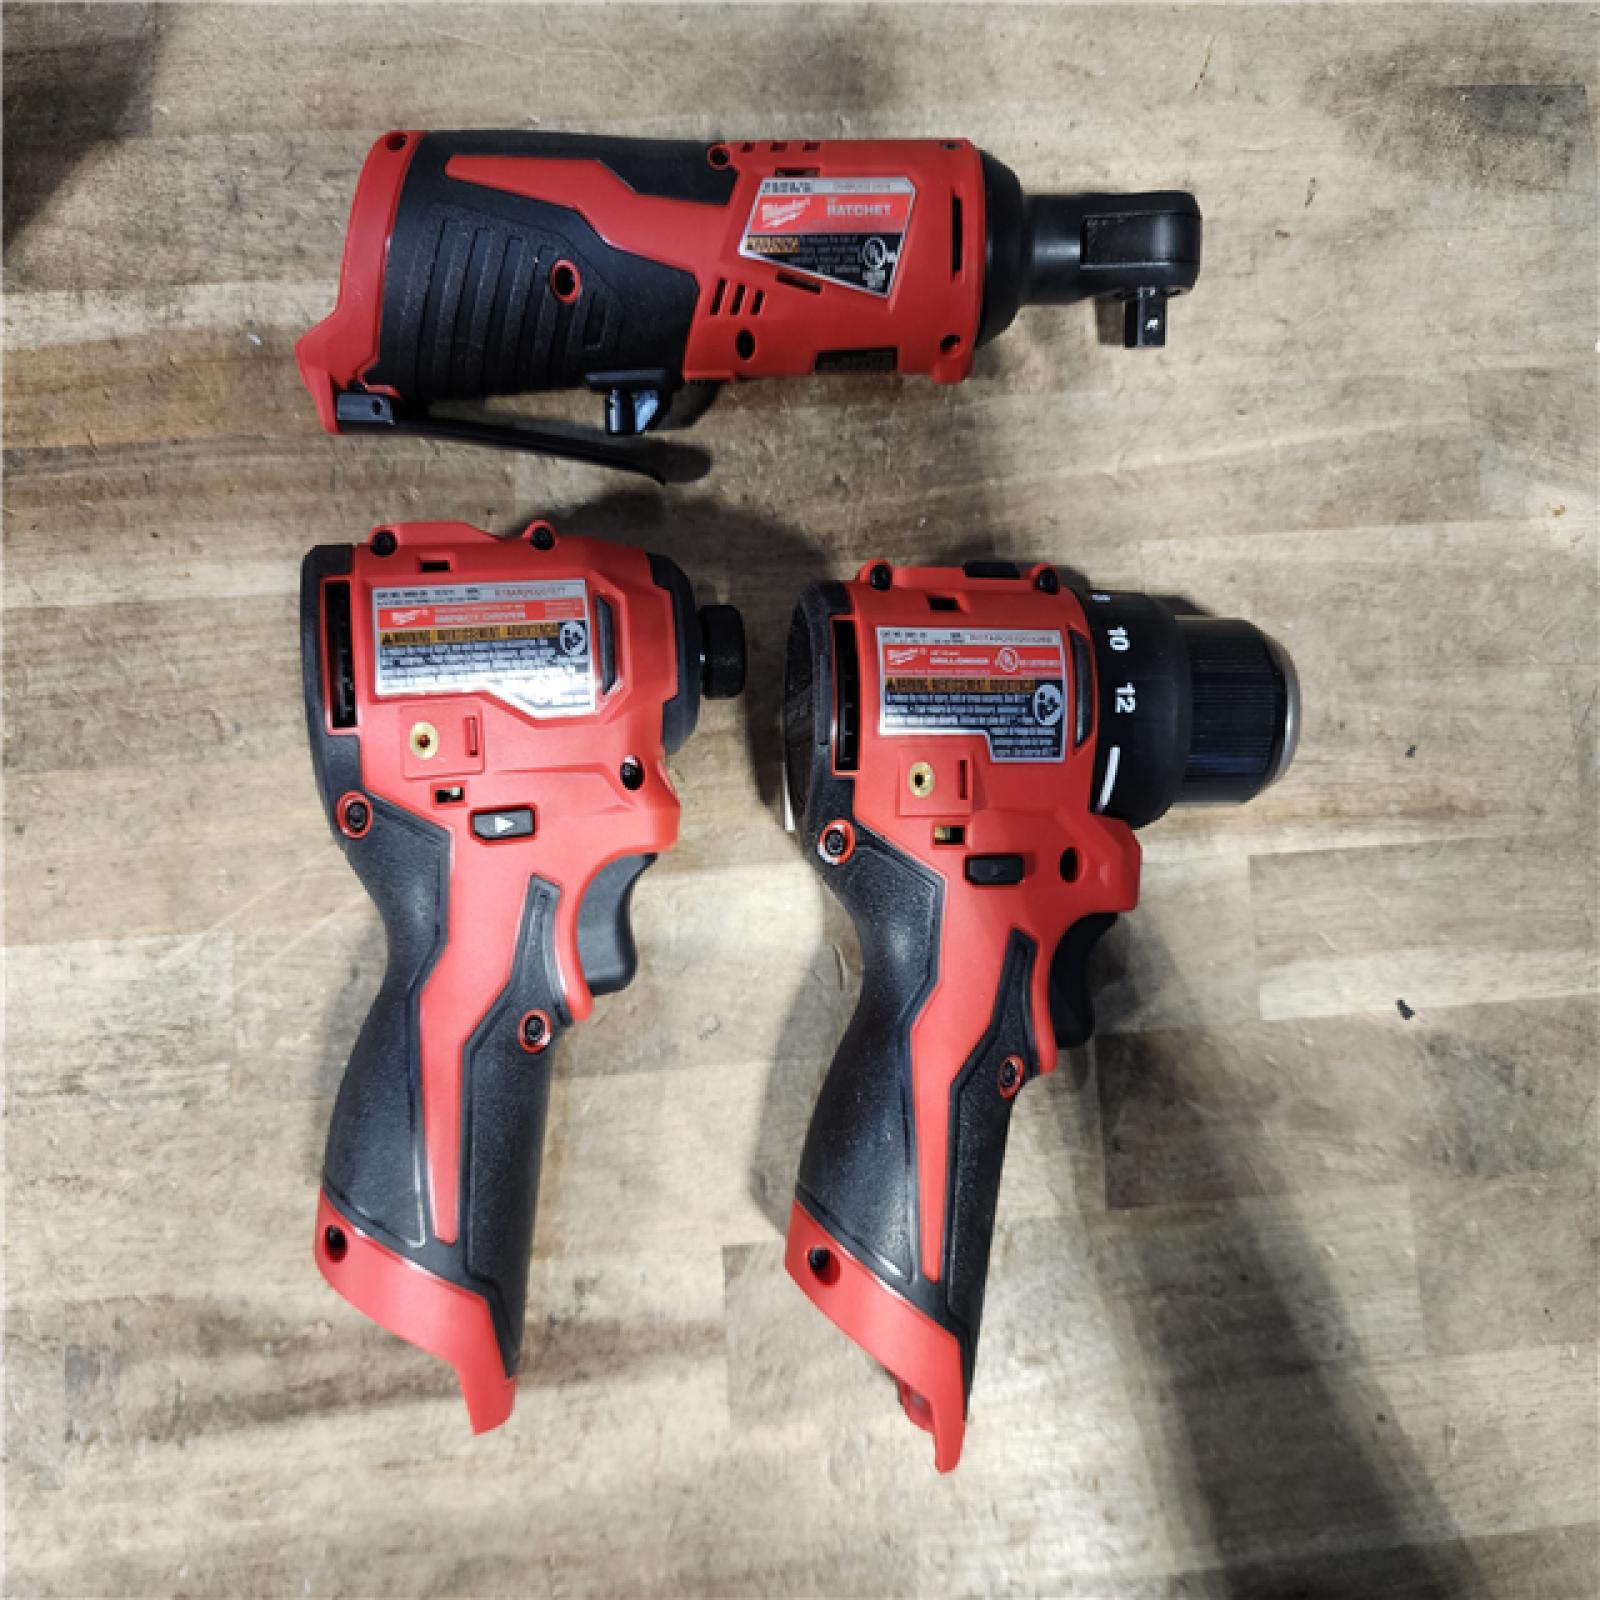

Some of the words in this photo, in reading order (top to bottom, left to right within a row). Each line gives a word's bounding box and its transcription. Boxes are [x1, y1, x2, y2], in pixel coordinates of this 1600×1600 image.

[827, 203, 893, 217] RATCHET
[1107, 625, 1130, 651] 10
[1115, 682, 1136, 713] 12
